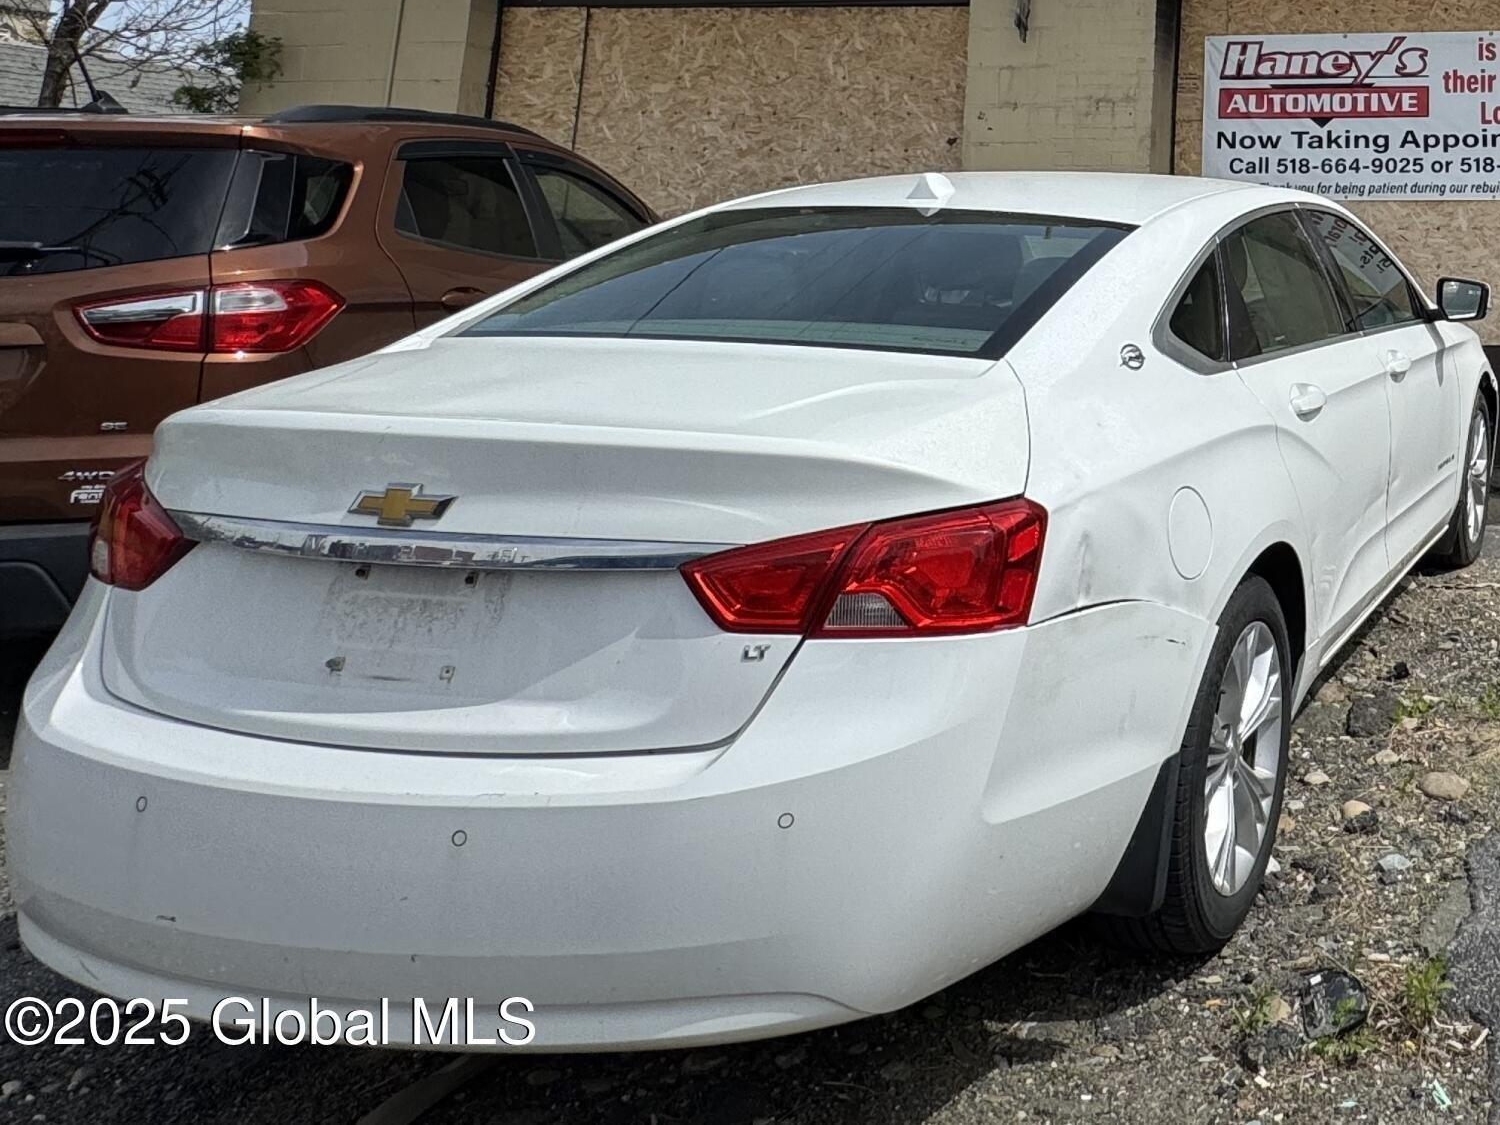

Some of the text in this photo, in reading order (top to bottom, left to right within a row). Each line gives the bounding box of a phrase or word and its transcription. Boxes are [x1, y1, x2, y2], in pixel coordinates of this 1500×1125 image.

[1478, 37, 1496, 61] is
[1219, 36, 1429, 84] Haney's
[1443, 72, 1496, 93] their
[1226, 92, 1418, 113] AUTOMOTIVE
[1216, 131, 1281, 150] Now
[1291, 130, 1390, 152] Taking
[1229, 156, 1270, 174] Call
[1276, 156, 1424, 174] 518-664-9025
[1430, 159, 1454, 173] or
[1316, 182, 1331, 194] for
[1334, 181, 1365, 196] being
[1368, 181, 1408, 196] patient
[1410, 181, 1446, 196] during
[1449, 182, 1469, 194] our
[100, 421, 128, 430] SE
[741, 643, 771, 662] LT
